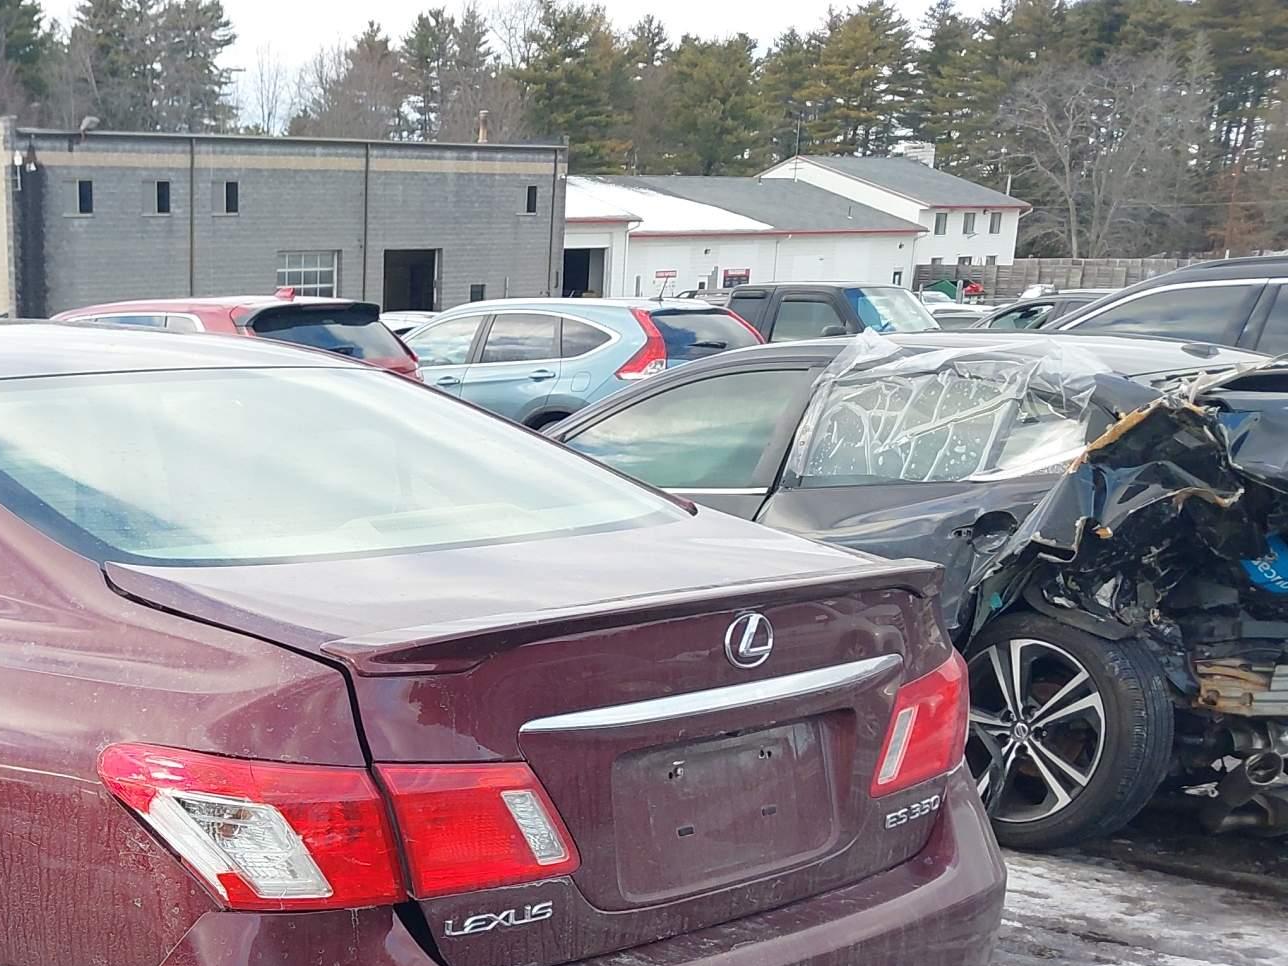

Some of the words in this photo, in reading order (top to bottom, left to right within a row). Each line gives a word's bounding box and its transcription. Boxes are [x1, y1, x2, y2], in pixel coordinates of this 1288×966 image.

[885, 808, 908, 830] ES
[910, 794, 940, 819] 350
[444, 900, 553, 936] LEXUS
